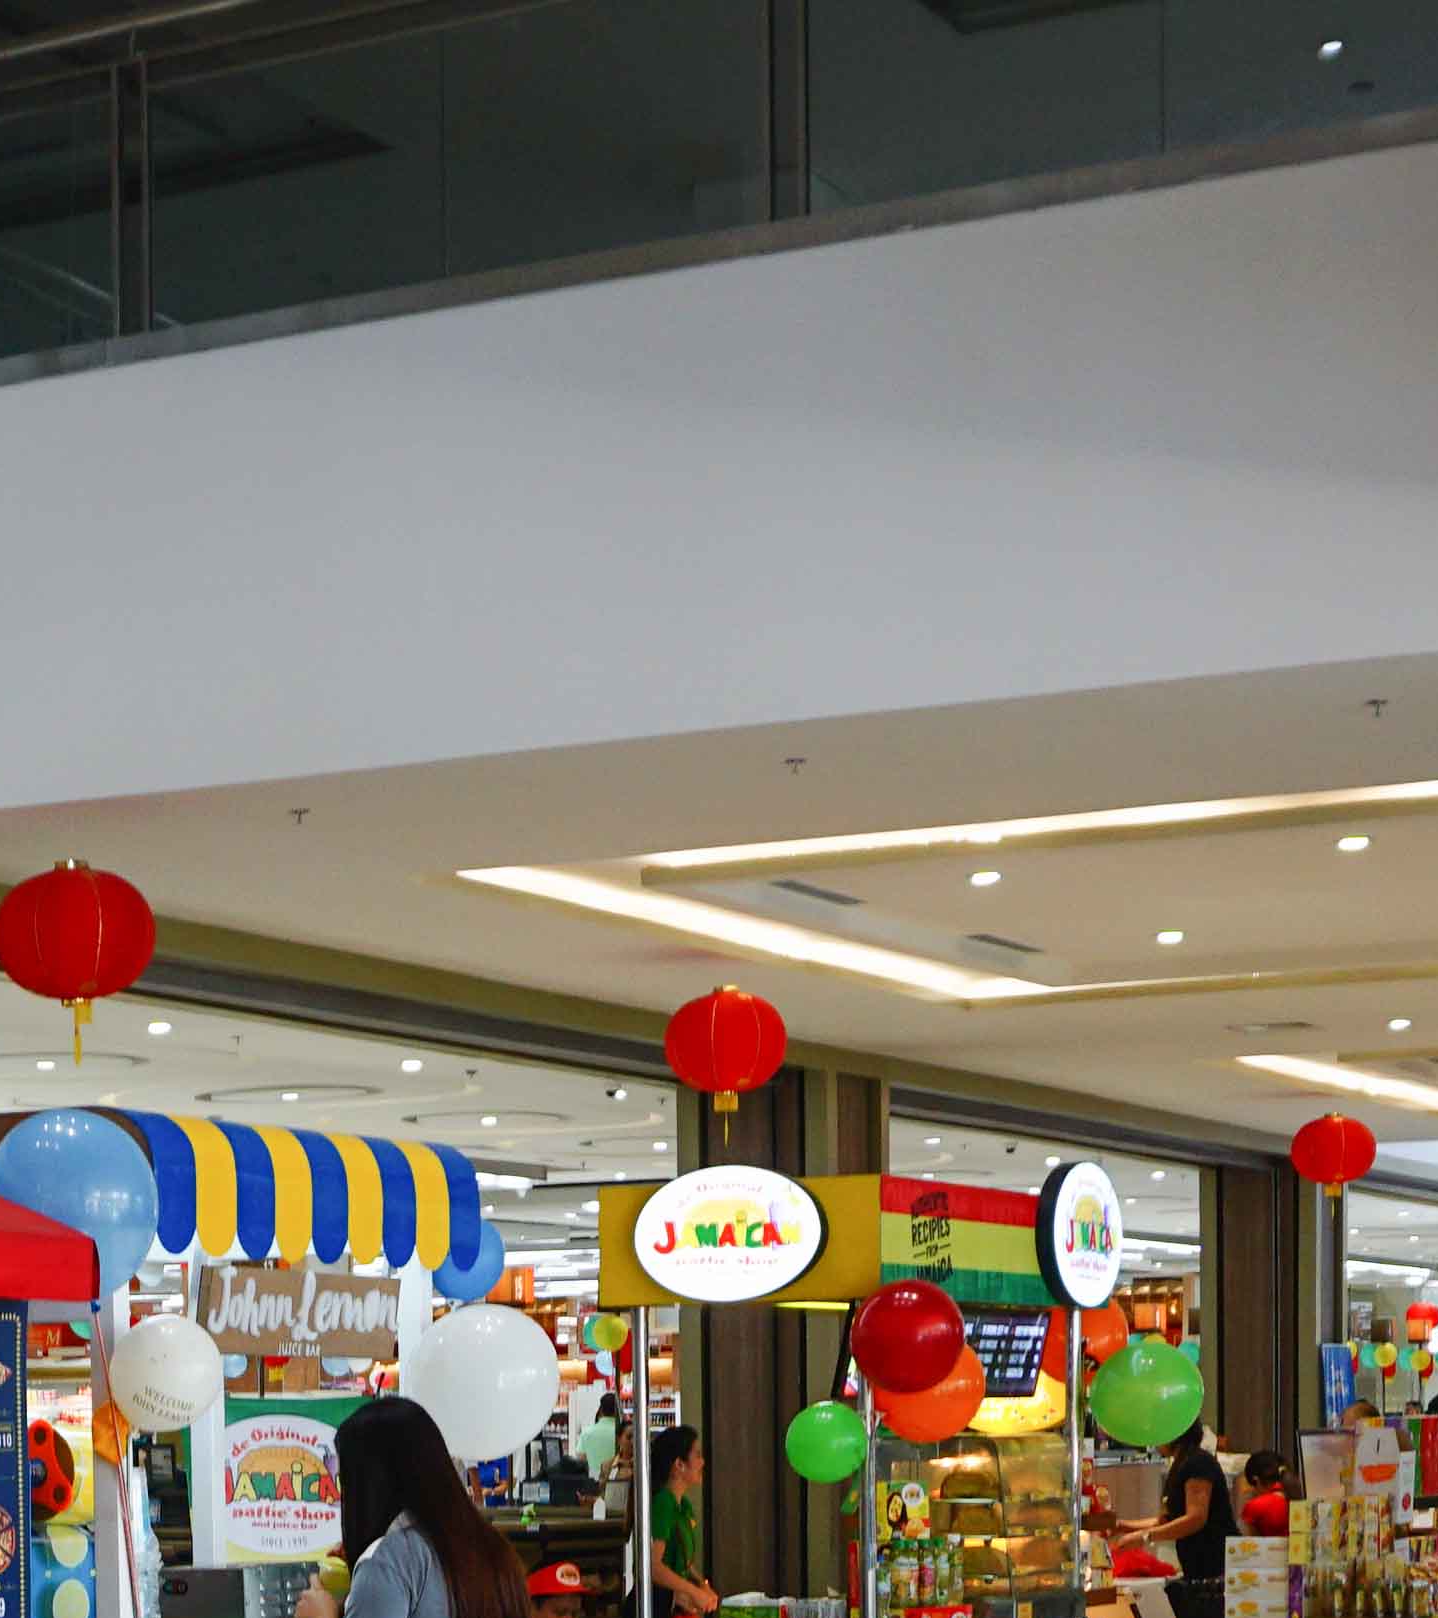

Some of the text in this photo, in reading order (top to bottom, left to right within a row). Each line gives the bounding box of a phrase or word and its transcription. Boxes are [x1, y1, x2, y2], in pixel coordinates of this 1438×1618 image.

[207, 1264, 399, 1342] John Lemon
[225, 1460, 343, 1505] JAMAICA
